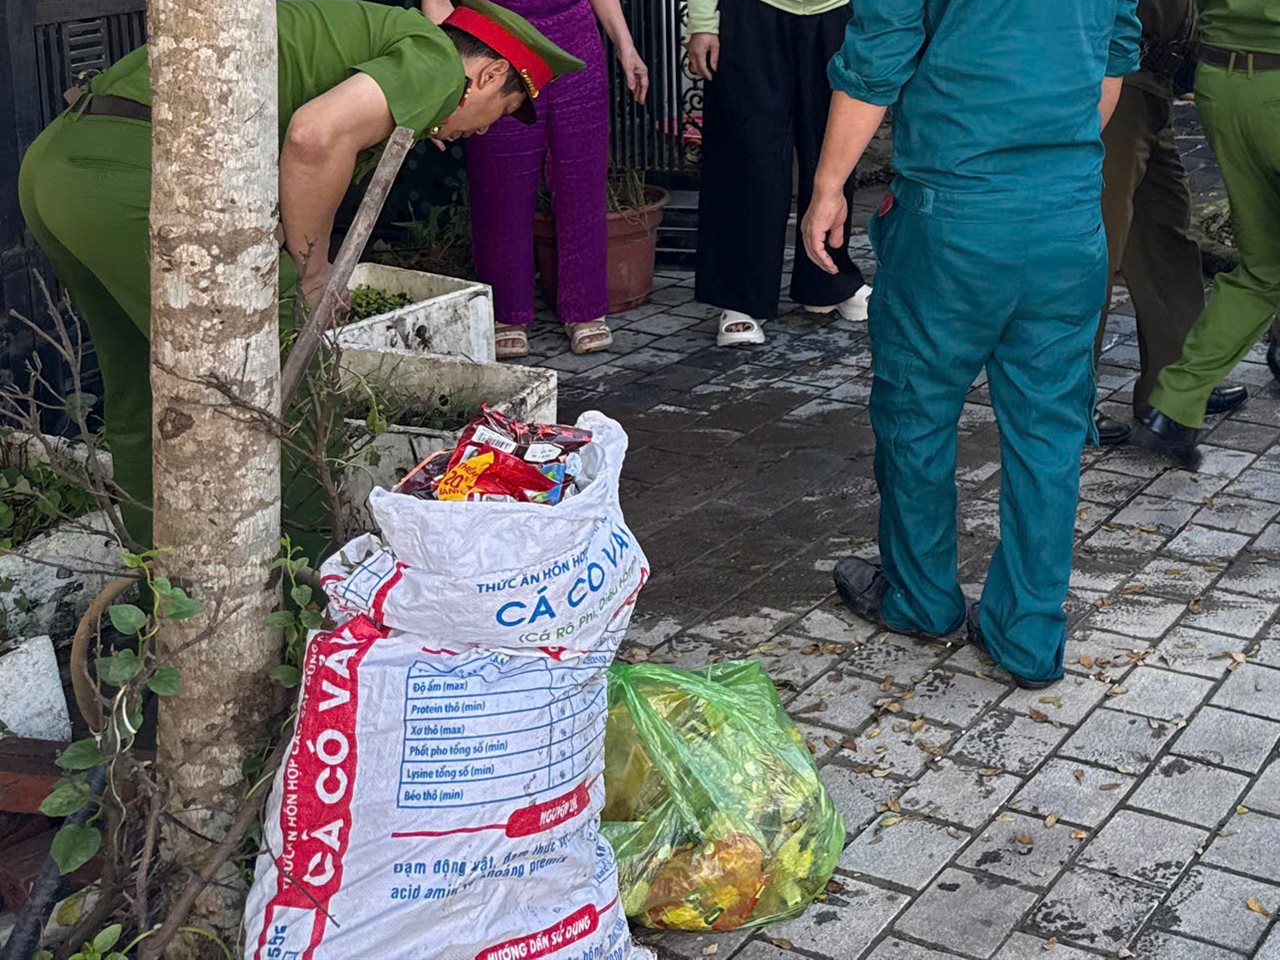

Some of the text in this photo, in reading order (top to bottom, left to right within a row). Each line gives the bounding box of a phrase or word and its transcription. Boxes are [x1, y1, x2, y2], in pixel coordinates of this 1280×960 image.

[476, 578, 517, 593] THỨC
[520, 572, 541, 587] ĂN
[542, 560, 570, 581] HỖN
[495, 585, 556, 627] CÁ
[443, 681, 468, 691] (max)
[411, 701, 485, 715] Protein thô (min)
[410, 724, 464, 735] Xơ thô (max)
[431, 745, 448, 757] pho
[472, 741, 483, 752] số
[485, 740, 508, 753] (min)
[305, 728, 350, 805] CÓ
[407, 766, 434, 780] Lysine
[458, 765, 470, 777] số
[471, 765, 495, 777] (min)
[404, 789, 464, 802] Béo thô (min)
[301, 818, 345, 887] CÁ
[433, 859, 467, 878] động
[390, 884, 421, 900] acid
[565, 915, 592, 940] DỤNG
